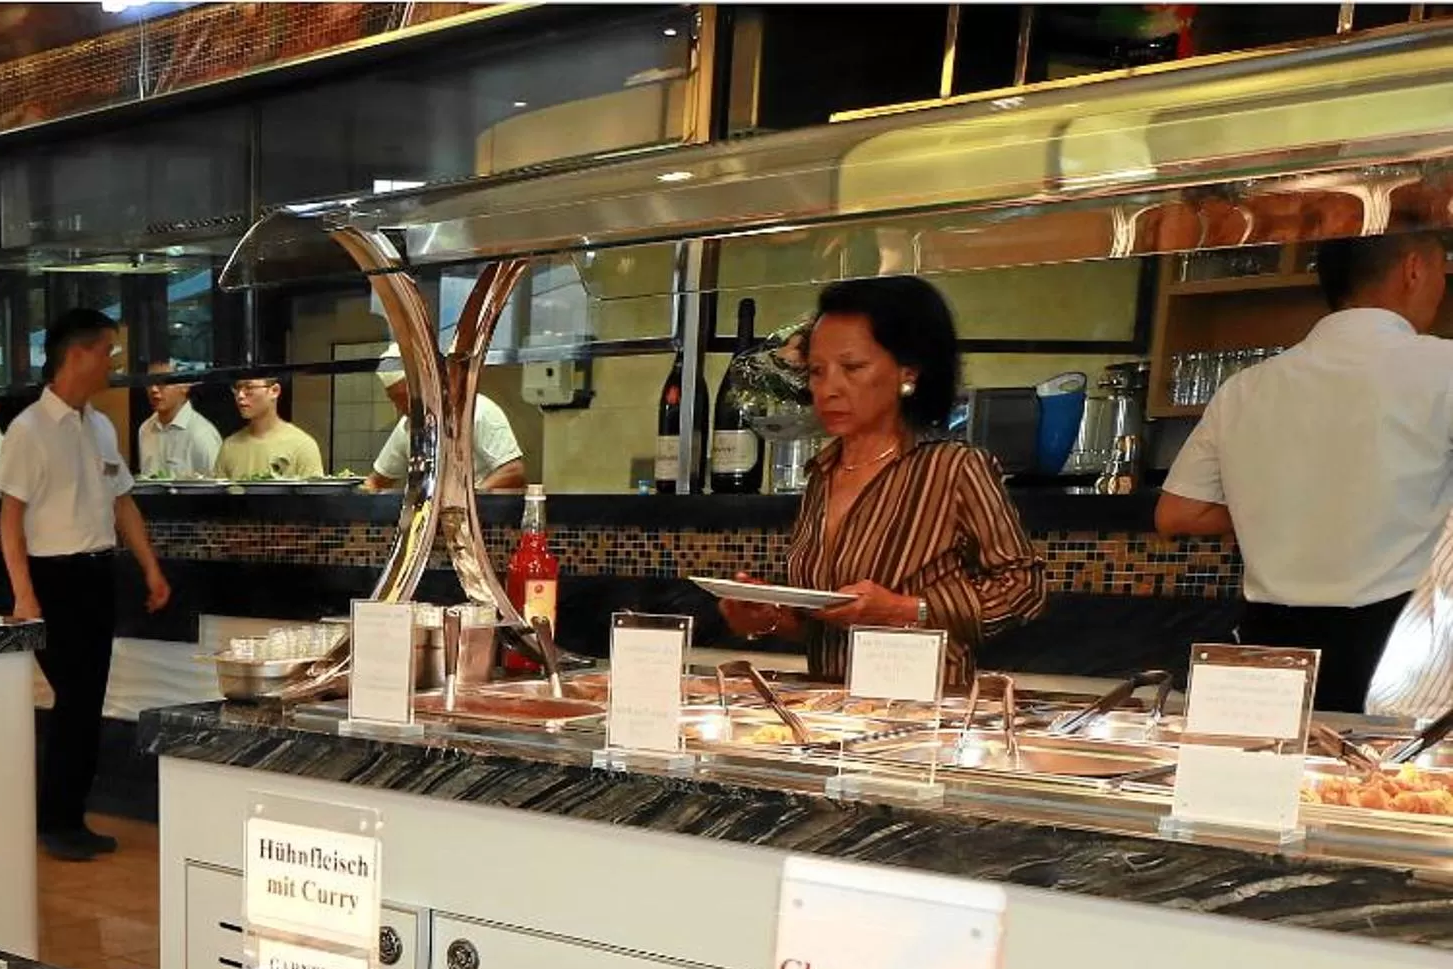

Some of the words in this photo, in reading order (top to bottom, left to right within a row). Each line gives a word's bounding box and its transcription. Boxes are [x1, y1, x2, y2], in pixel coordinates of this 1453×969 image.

[259, 838, 369, 877] Hühnfleisch
[268, 876, 296, 898] mit
[301, 879, 359, 916] Curry
